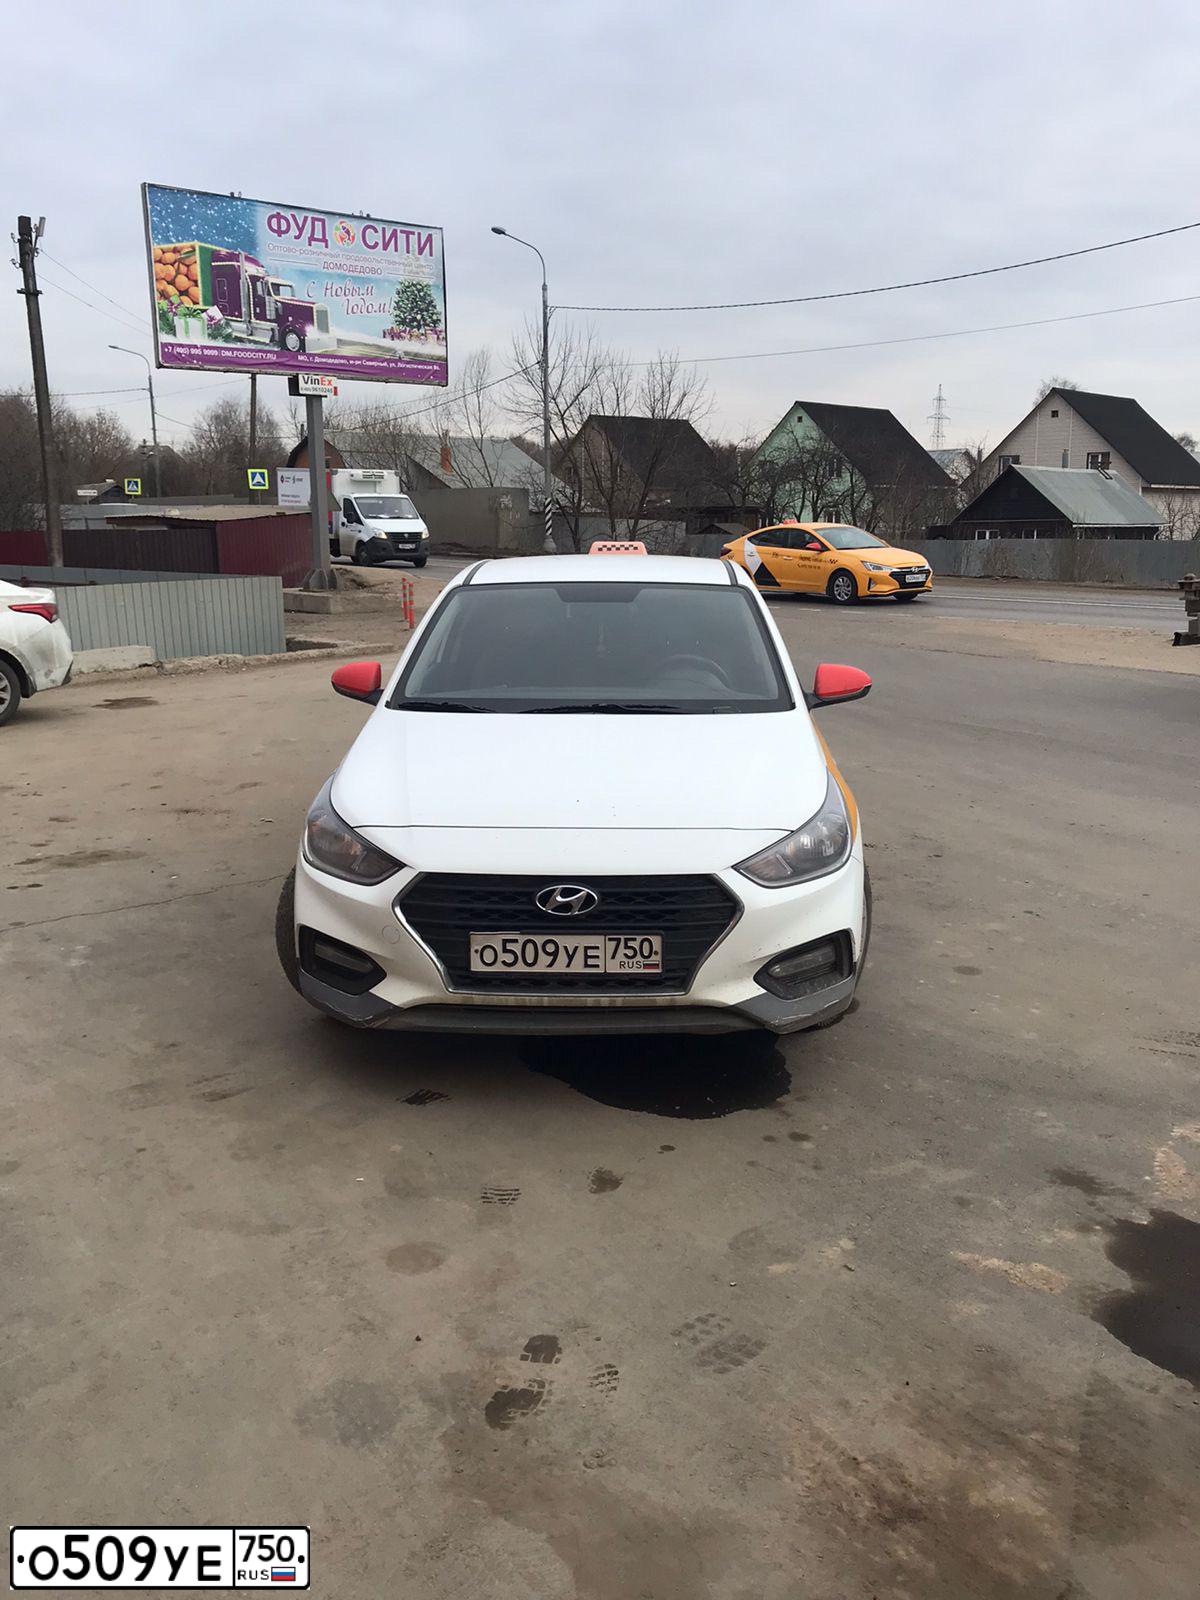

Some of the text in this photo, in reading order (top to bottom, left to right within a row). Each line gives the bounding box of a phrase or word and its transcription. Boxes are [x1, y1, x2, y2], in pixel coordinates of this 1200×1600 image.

[267, 212, 434, 257] ФУД СИТИ
[323, 260, 383, 276] ДОМОДЕДОВО
[306, 277, 374, 298] С Новым
[302, 375, 334, 386] VinEx
[607, 937, 654, 960] 750
[619, 961, 642, 969] RUS
